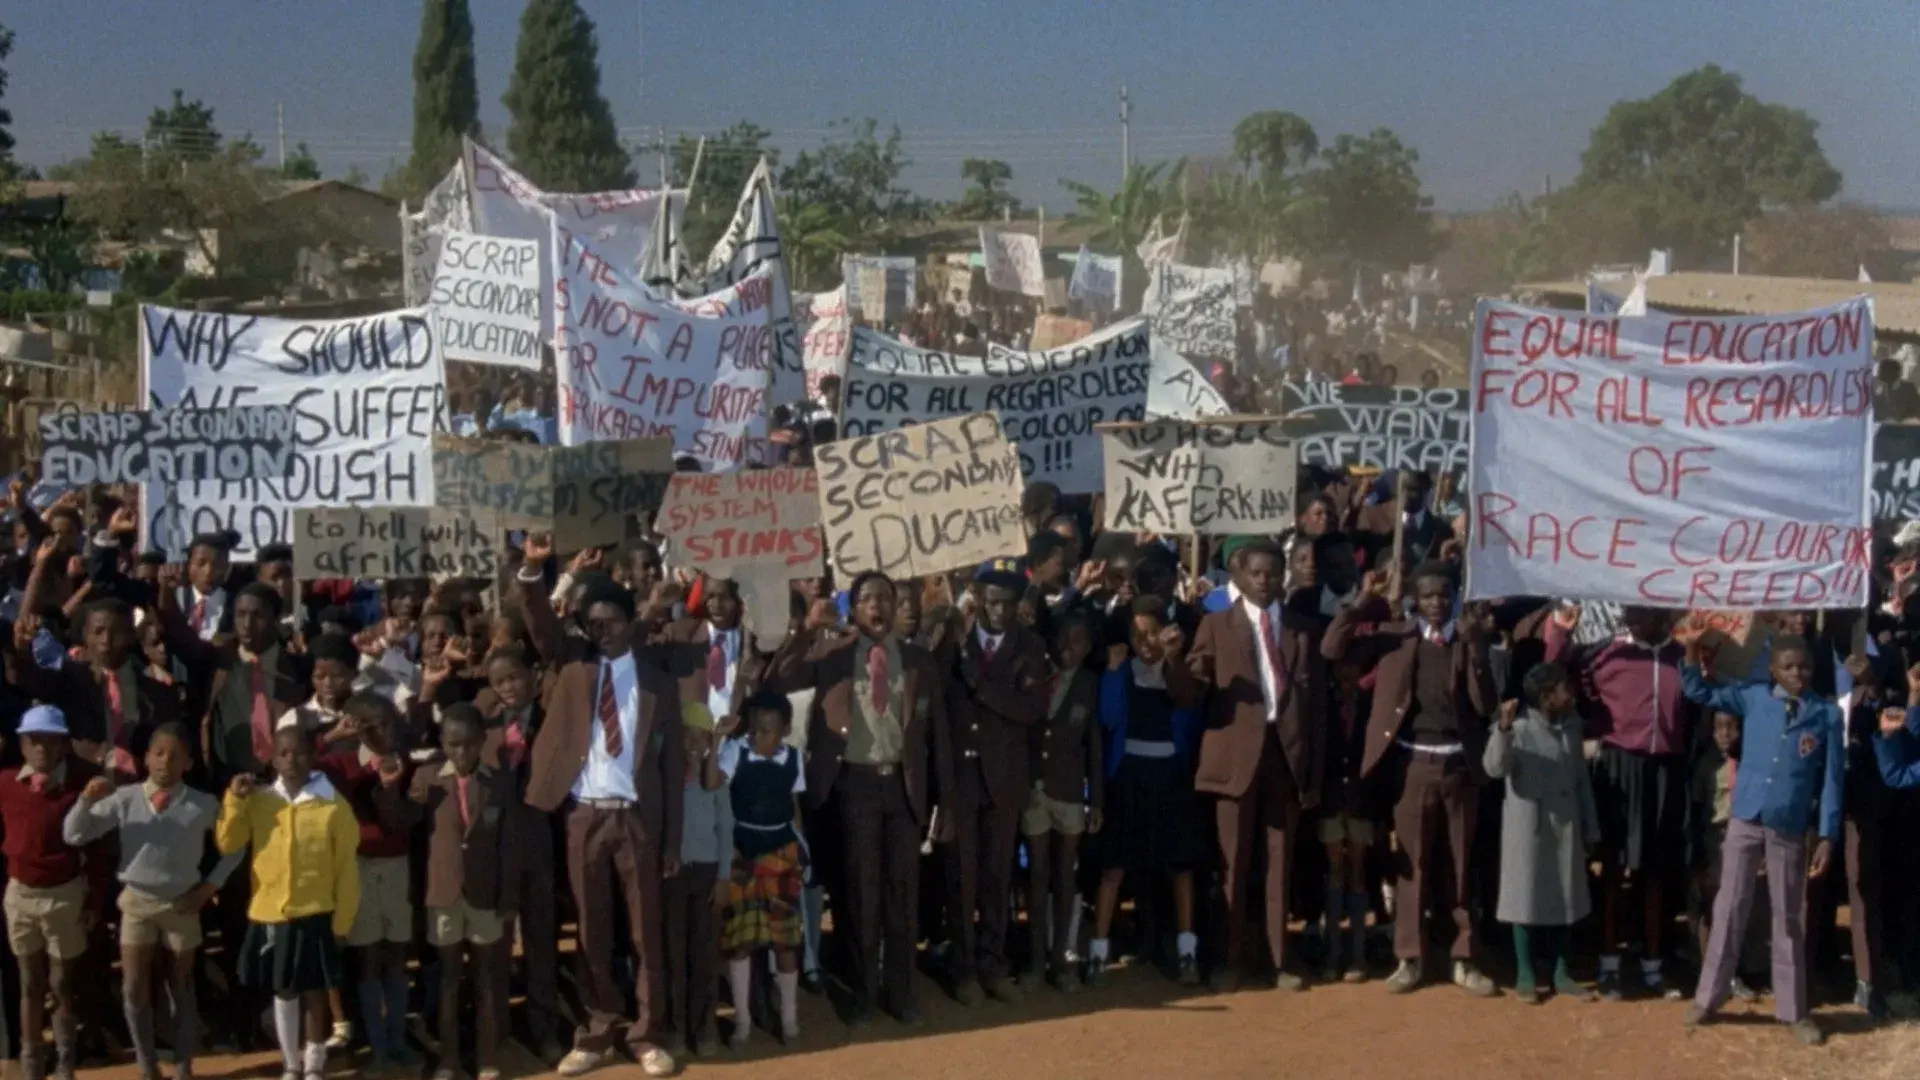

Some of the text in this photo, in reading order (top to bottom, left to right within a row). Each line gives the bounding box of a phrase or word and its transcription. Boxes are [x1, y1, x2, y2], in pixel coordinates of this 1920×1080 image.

[444, 237, 535, 278] SCRAP
[143, 305, 433, 375] WHY SHOULD
[440, 316, 541, 361] DUCATION
[579, 293, 660, 347] NOT
[666, 322, 694, 362] A
[1482, 306, 1863, 366] EQUAL EDUCATION
[851, 333, 1148, 377] EQUAL EDUCATION
[847, 380, 909, 413] FOR
[927, 385, 973, 412] ALL
[986, 362, 1149, 413] REGARDLESS
[1282, 380, 1459, 410] WE DO
[1477, 369, 1580, 419] FOR
[1596, 376, 1663, 426] ALL
[39, 405, 297, 446] SCRAP SECONDARY
[289, 382, 455, 445] SUFFER
[1337, 407, 1468, 440] WANT
[818, 412, 1000, 480] SCRAP
[671, 465, 819, 499] THE WHOLE
[1628, 446, 1714, 500] OF
[307, 511, 489, 547] to hell with
[667, 497, 778, 532] SYSTEM
[1477, 492, 1646, 568] RACE
[1670, 516, 1836, 567] COLOUR
[685, 527, 822, 566] STINKS
